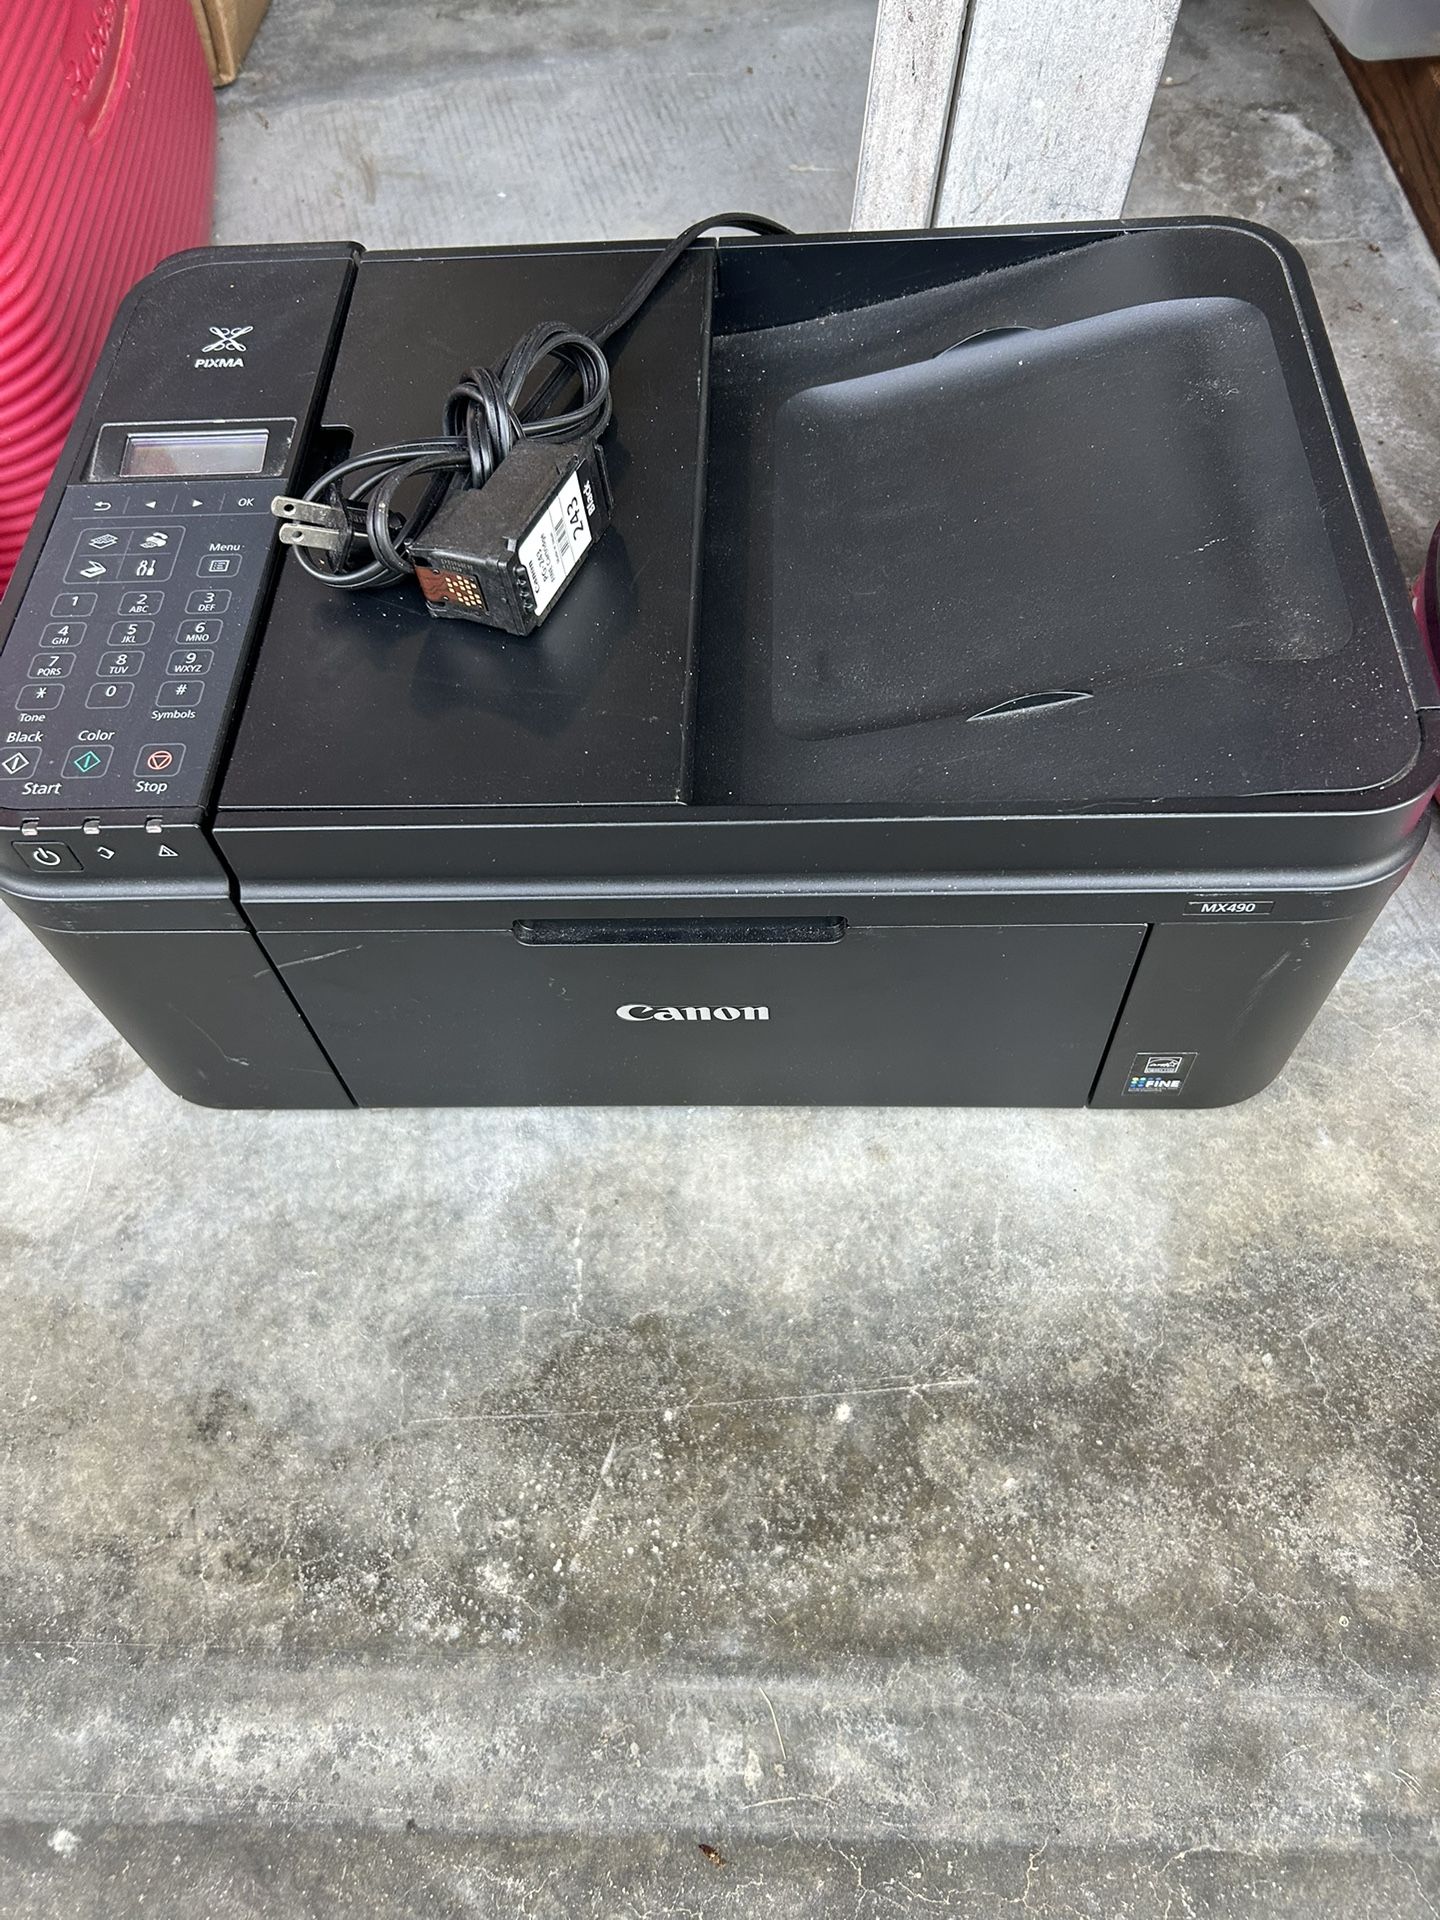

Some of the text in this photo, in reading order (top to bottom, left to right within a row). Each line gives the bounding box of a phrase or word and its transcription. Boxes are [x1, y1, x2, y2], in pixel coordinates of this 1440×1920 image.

[195, 358, 244, 368] PIXMA
[237, 498, 255, 507] OK
[583, 480, 596, 516] Black
[567, 497, 584, 540] 243
[209, 543, 241, 551] Menu
[72, 596, 79, 606] 1
[137, 594, 147, 605] 2
[204, 592, 215, 603] 3
[129, 605, 149, 613] ABC
[198, 603, 216, 611] DEF
[58, 625, 69, 636] 4
[126, 624, 137, 635] 5
[195, 622, 205, 633] 6
[52, 636, 70, 645] GHI
[121, 635, 137, 643] JKL
[185, 634, 209, 642] MNO
[50, 656, 59, 667] 7
[116, 654, 127, 665] 8
[186, 653, 197, 664] 9
[37, 667, 62, 677] PQRS
[109, 666, 129, 674] TUV
[174, 664, 202, 673] WXYZ
[105, 686, 117, 697] 0
[175, 684, 188, 695] #
[19, 713, 46, 722] Tone
[151, 710, 196, 720] Symbols
[6, 732, 44, 742] Black
[78, 730, 115, 742] Color
[22, 782, 62, 796] Start
[136, 781, 168, 794] Stop
[1201, 903, 1256, 913] MX490
[616, 1004, 769, 1021] Canon
[1145, 1080, 1181, 1088] FINE
